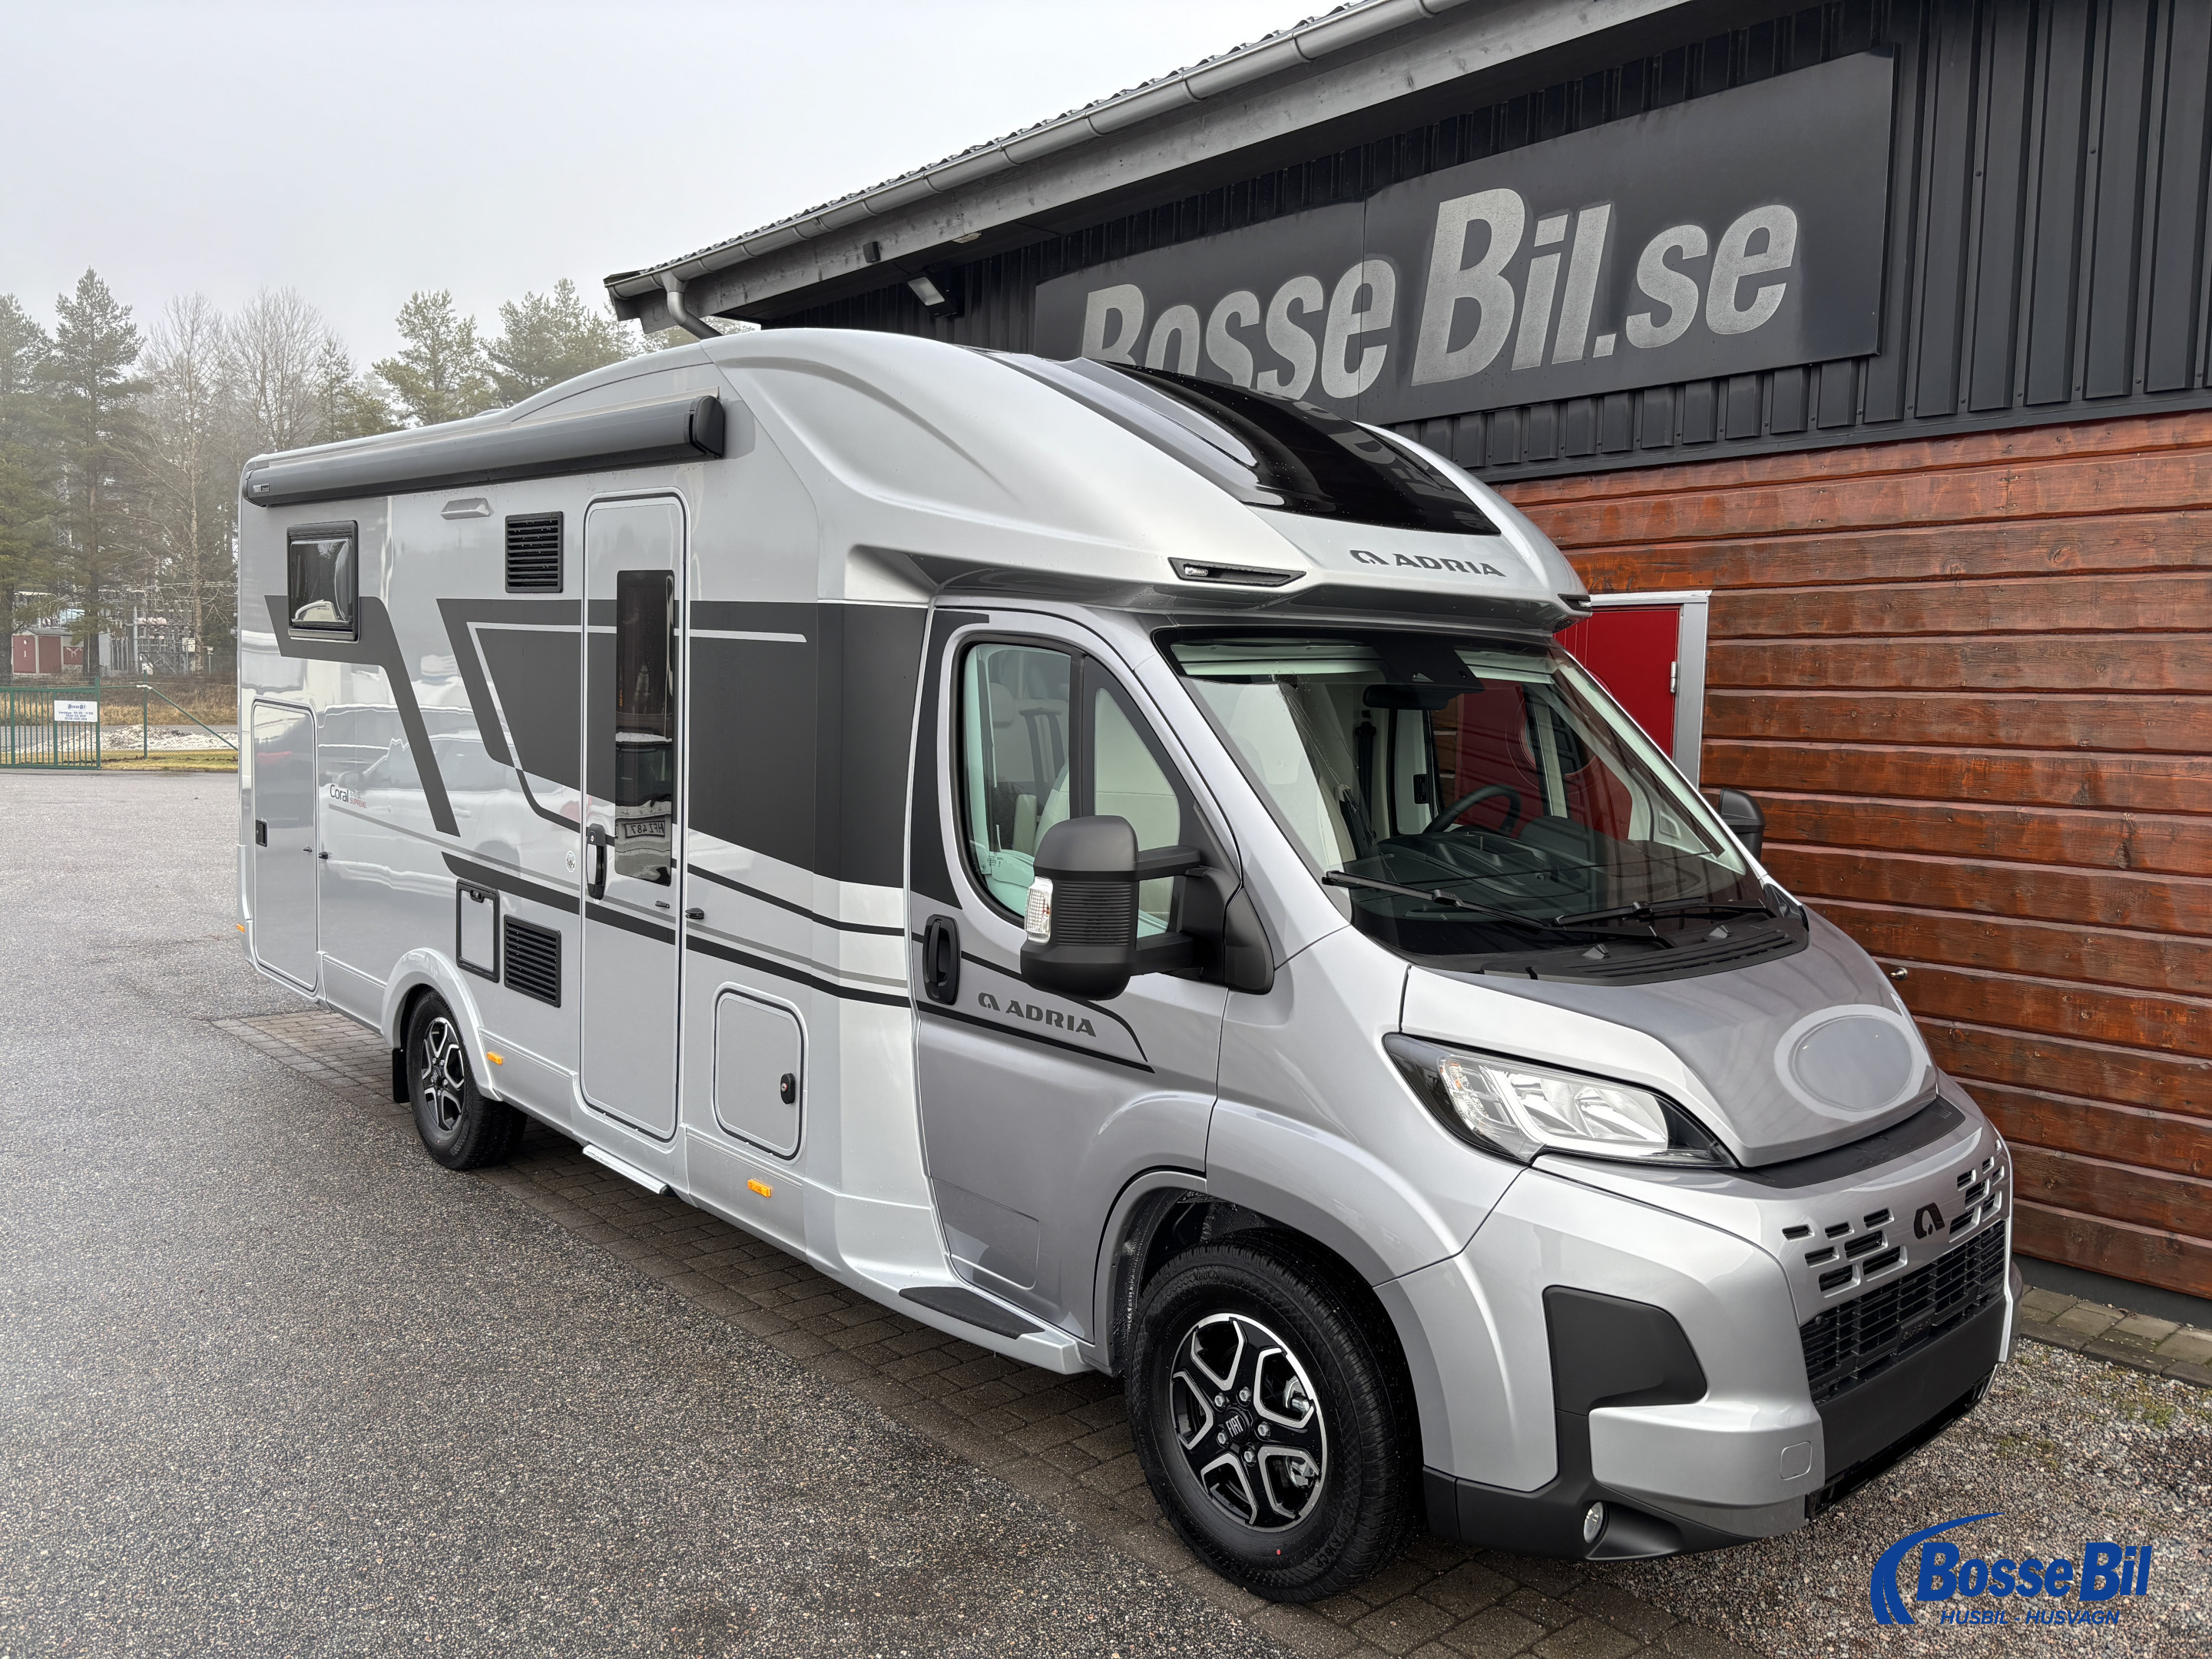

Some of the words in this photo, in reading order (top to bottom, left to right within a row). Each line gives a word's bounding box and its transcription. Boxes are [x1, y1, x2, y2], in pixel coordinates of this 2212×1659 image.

[1411, 188, 1797, 386] Bil.se
[1392, 553, 1507, 577] ADRIA
[330, 784, 349, 803] Coral
[349, 797, 367, 809] SUPREME
[1005, 999, 1097, 1038] ADRIA
[1225, 1415, 1244, 1438] FIAT
